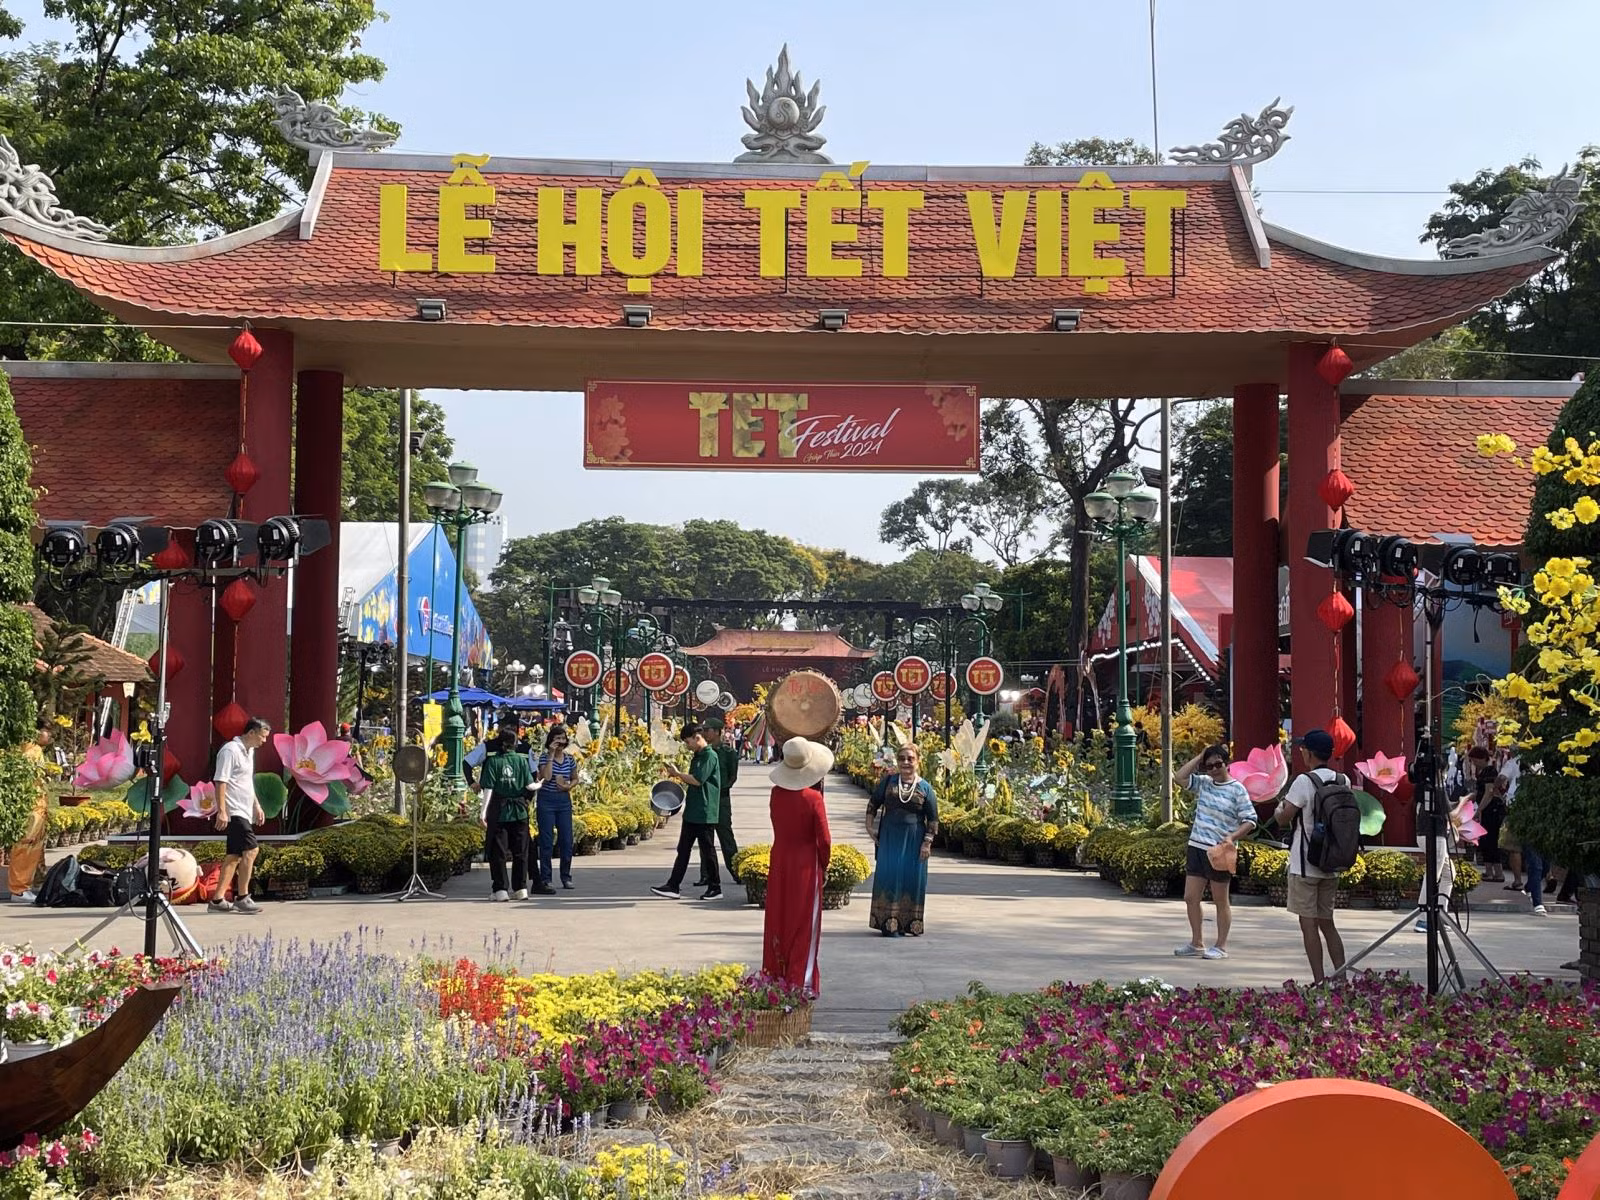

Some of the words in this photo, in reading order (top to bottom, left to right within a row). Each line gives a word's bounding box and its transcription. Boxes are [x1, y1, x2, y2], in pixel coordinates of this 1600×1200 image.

[379, 153, 496, 274] LỄ
[537, 166, 704, 295] HỘI
[744, 160, 926, 278] TẾT
[966, 171, 1188, 294] VIỆT
[785, 408, 902, 458] Festival
[840, 439, 883, 459] 2024
